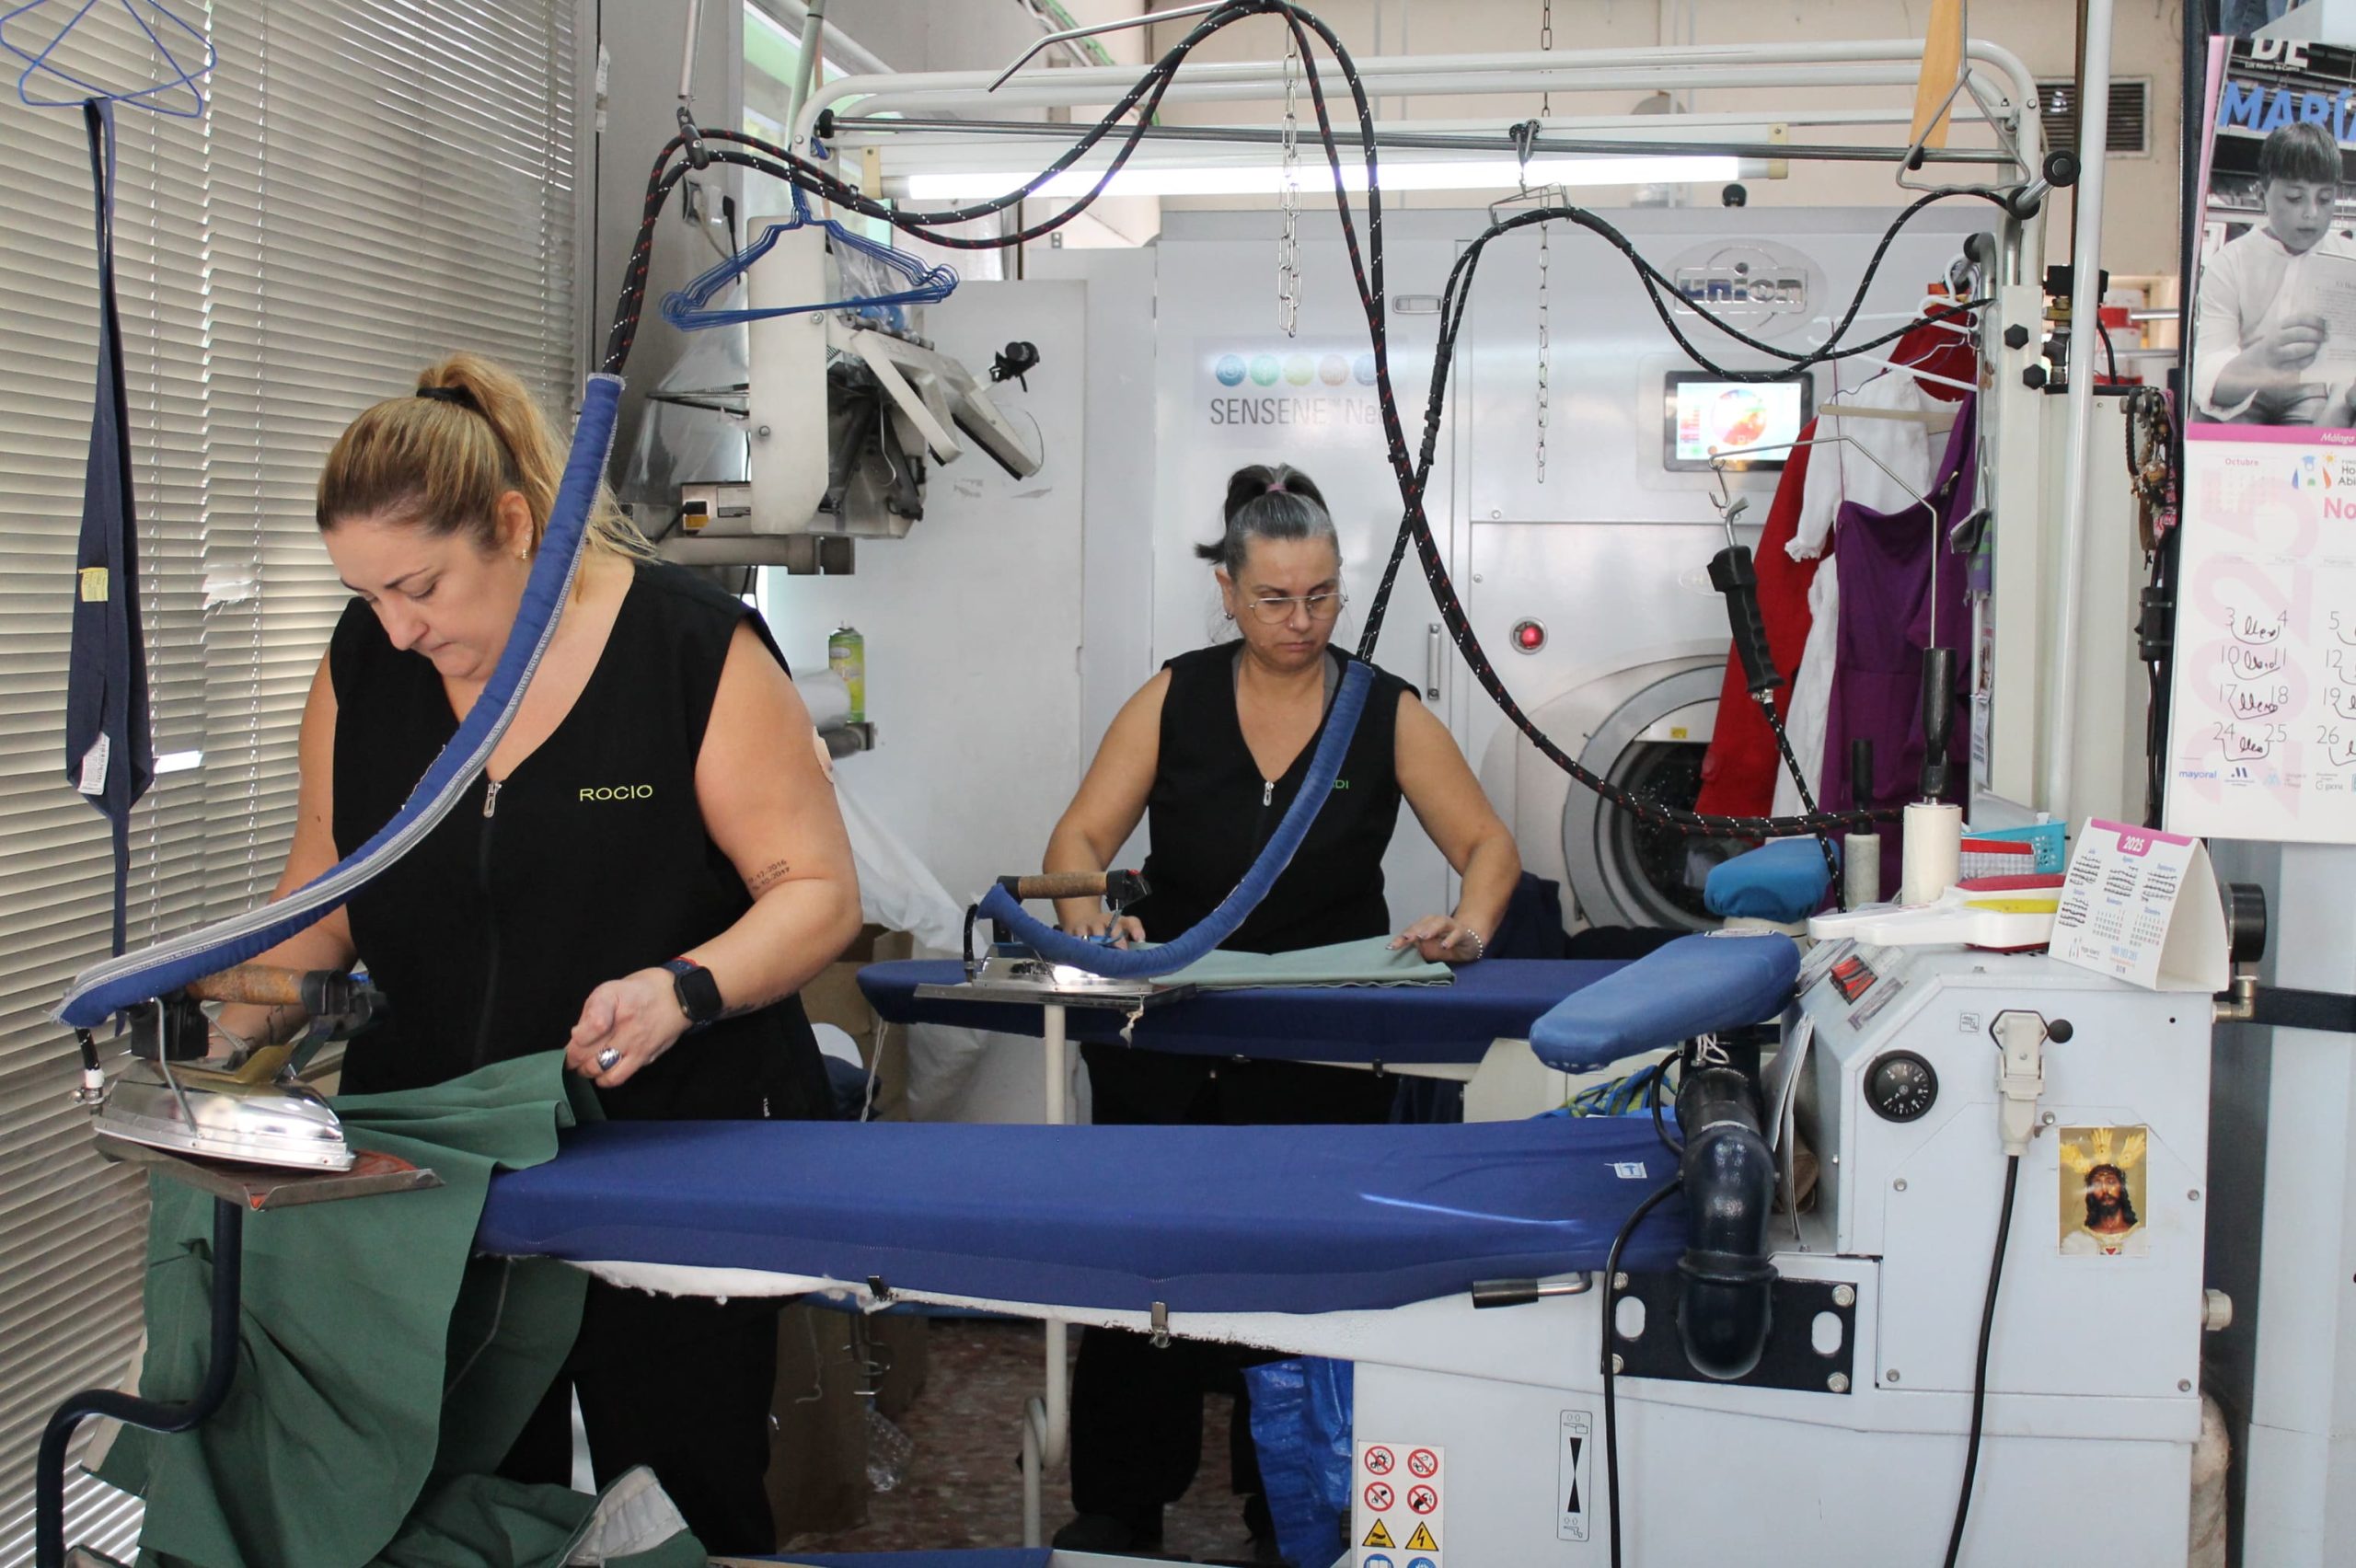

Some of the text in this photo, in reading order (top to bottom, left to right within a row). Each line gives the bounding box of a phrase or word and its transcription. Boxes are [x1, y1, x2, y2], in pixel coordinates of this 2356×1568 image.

[1345, 398, 1383, 425] Ne
[2225, 458, 2259, 467] Octubre
[2224, 606, 2339, 630] 3 4 5
[2221, 644, 2343, 669] 10 11 12
[2219, 683, 2237, 703] 17
[2270, 685, 2289, 705] 18
[2323, 686, 2341, 706] 19
[2212, 721, 2339, 745] 24 25 26
[1333, 779, 1349, 790] DI
[2178, 769, 2217, 780] mayoral
[579, 784, 653, 801] ROCIO
[2122, 836, 2145, 852] 2025
